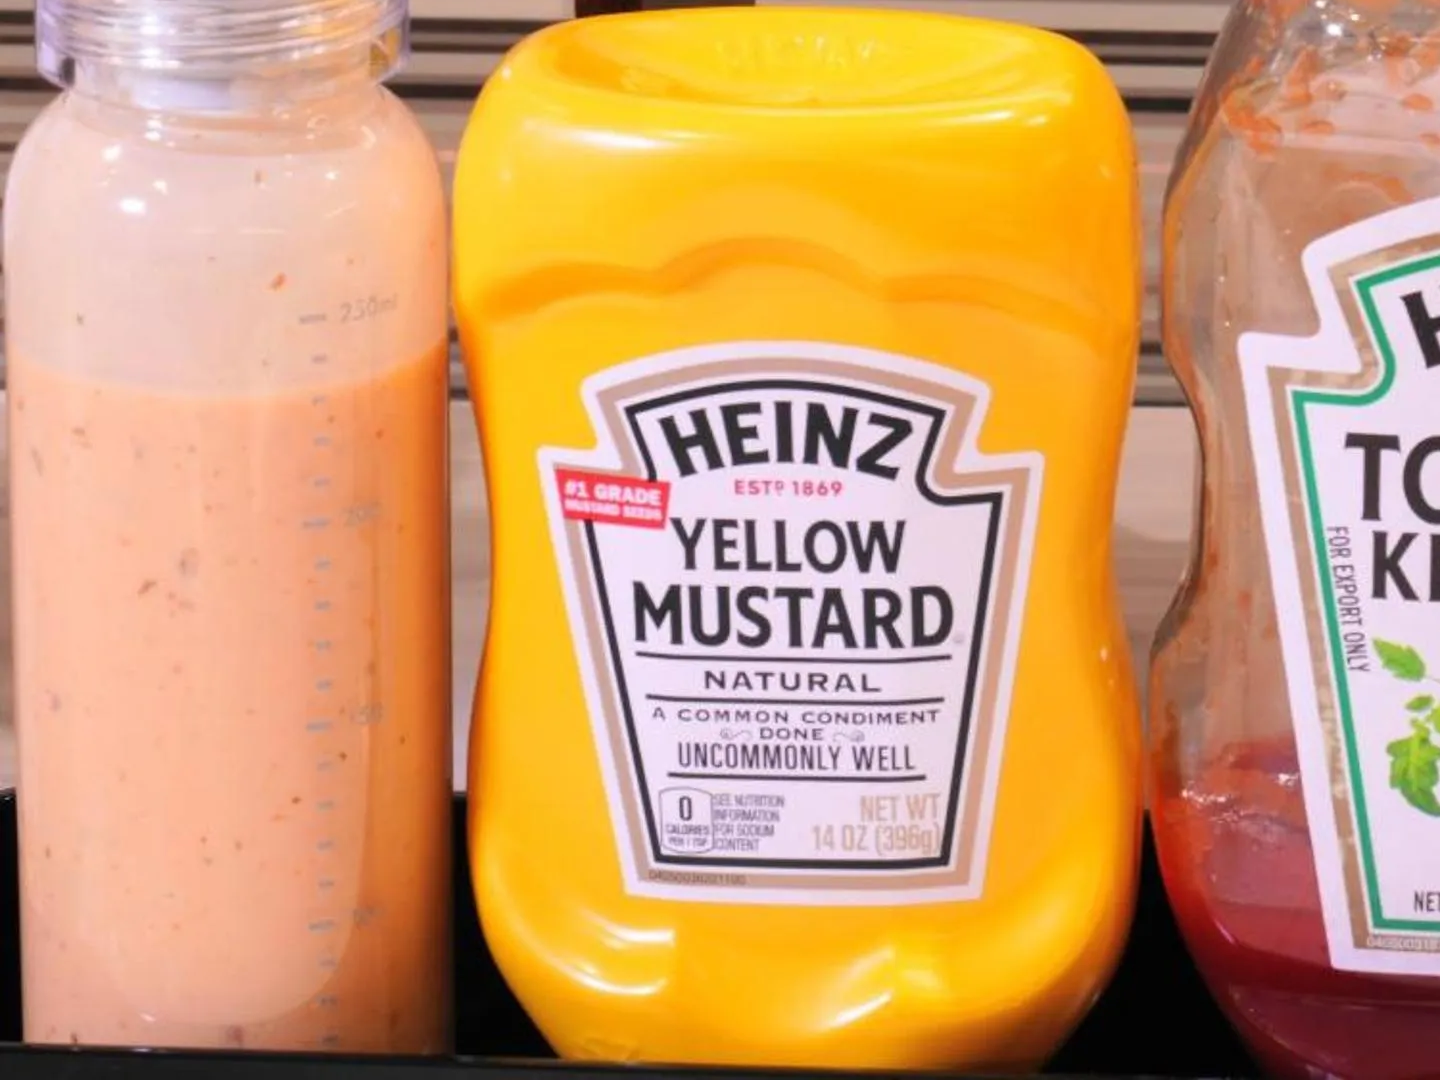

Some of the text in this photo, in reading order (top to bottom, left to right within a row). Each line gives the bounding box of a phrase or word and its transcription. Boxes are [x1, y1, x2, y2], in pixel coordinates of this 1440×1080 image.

[658, 401, 914, 480] HEINZ
[593, 483, 662, 506] GRADE
[792, 480, 843, 497] 1869
[669, 517, 906, 573] YELLOW
[1327, 526, 1371, 672] FOR EXPORT ONLY
[633, 581, 954, 650] MUSTARD
[704, 670, 881, 694] NATURAL
[652, 706, 940, 725] A COMMON CONDIMENT
[759, 727, 824, 740] DONE
[678, 742, 915, 771] UNCOMMONLY WELL
[860, 792, 941, 822] NET WT
[812, 822, 941, 857] 14 OZ (396g)
